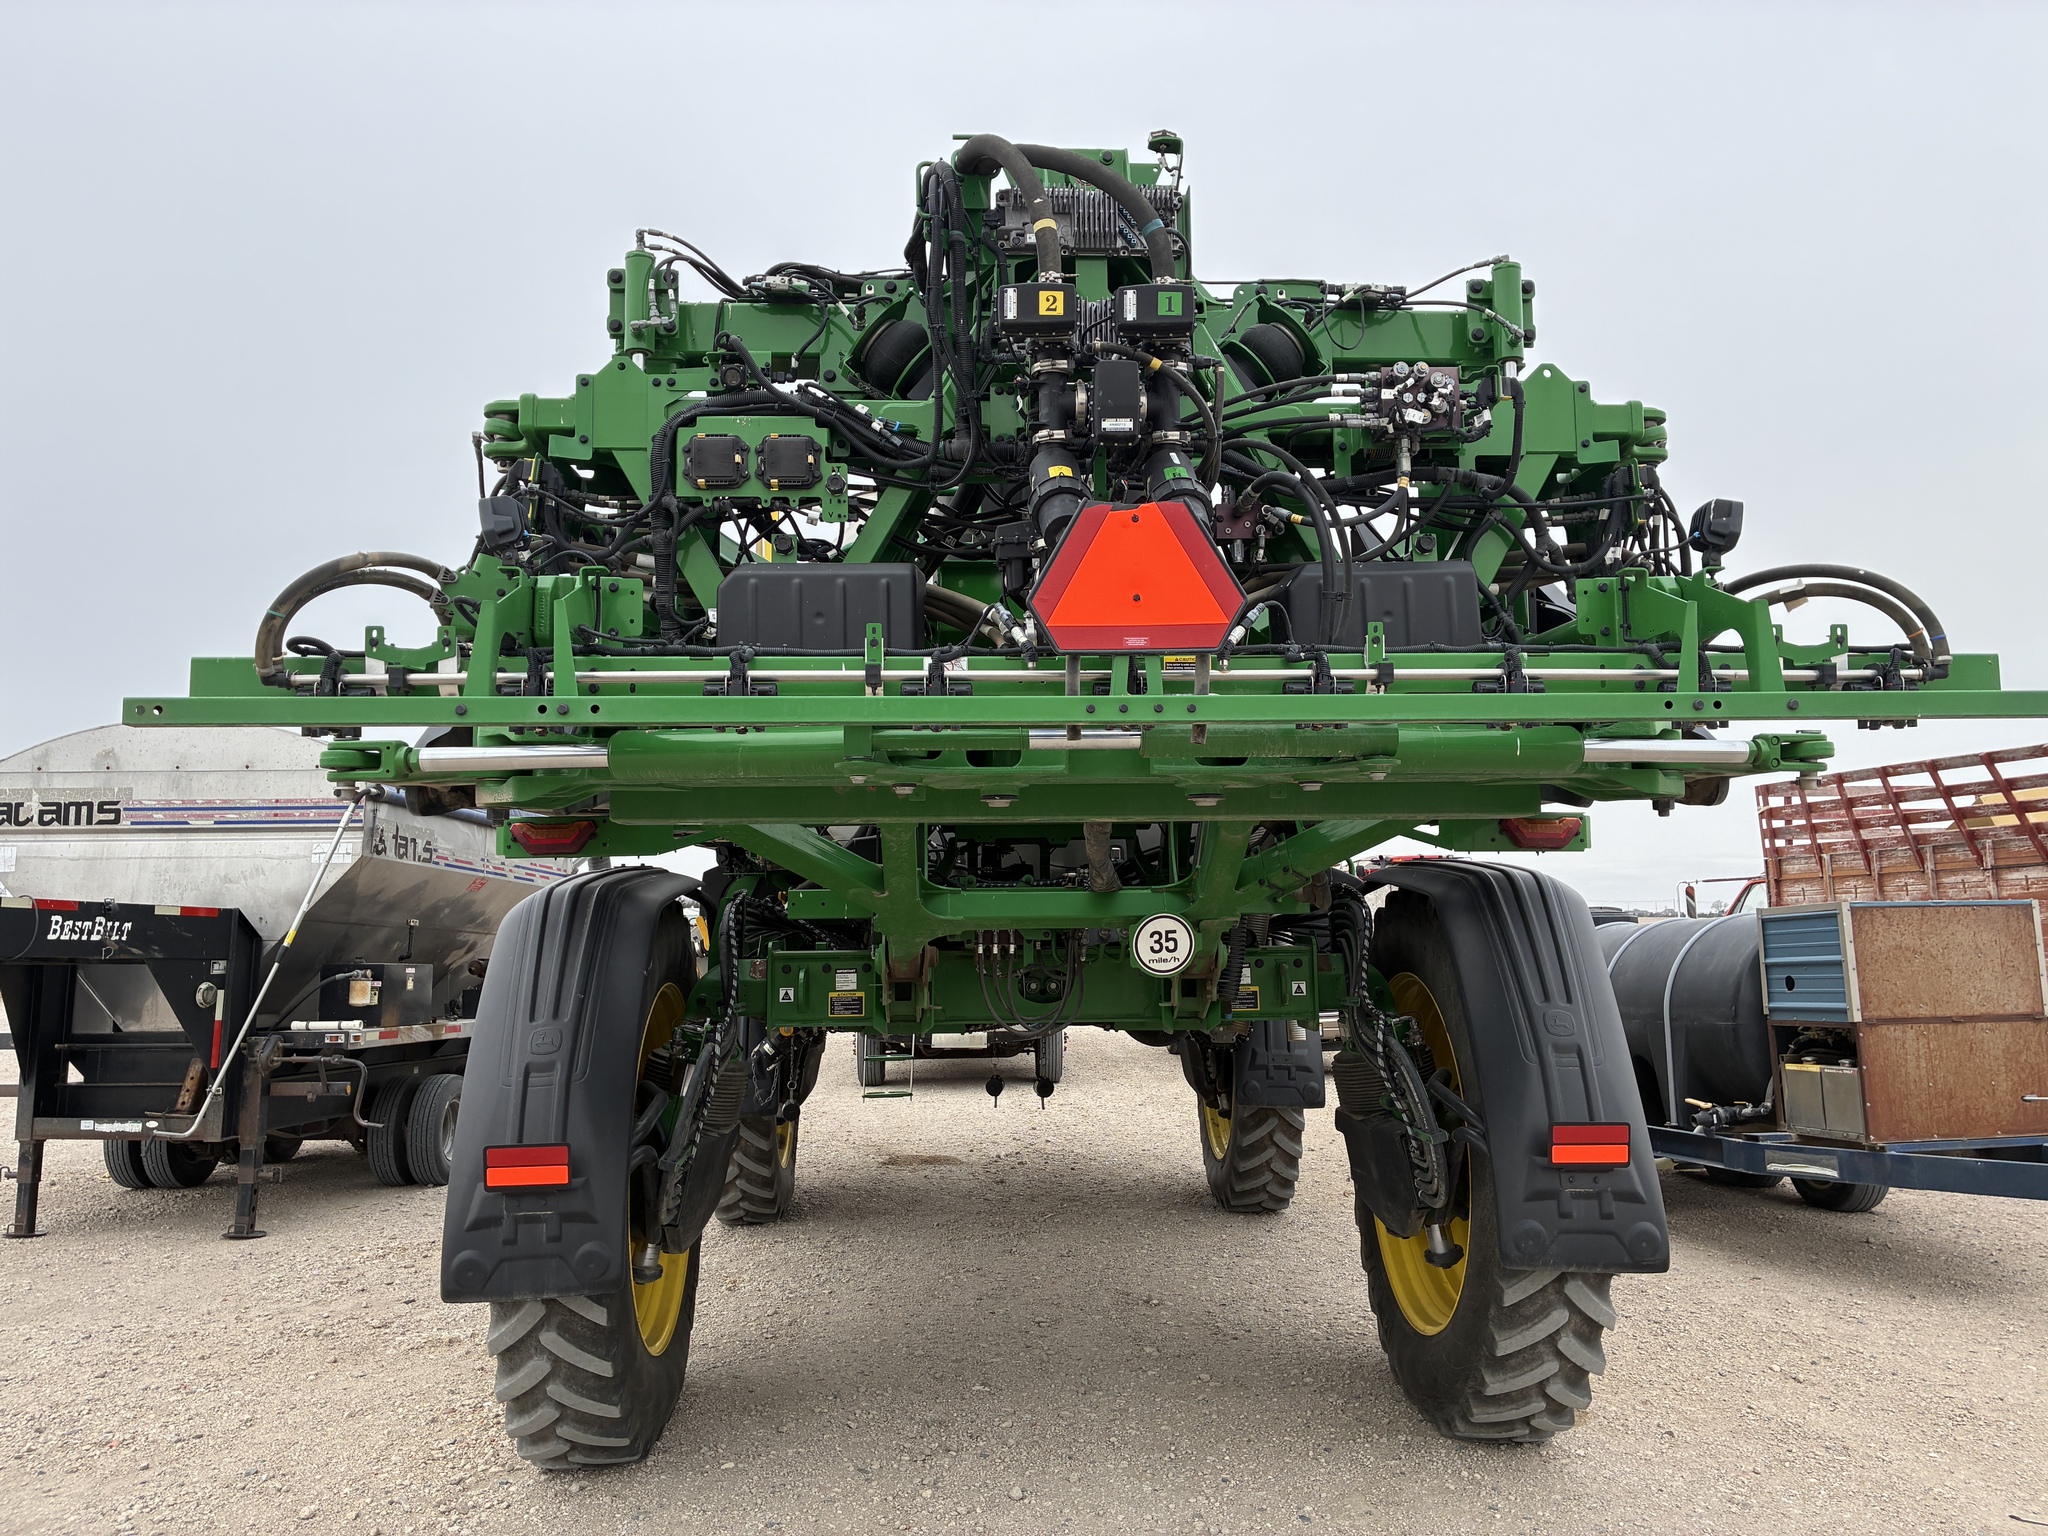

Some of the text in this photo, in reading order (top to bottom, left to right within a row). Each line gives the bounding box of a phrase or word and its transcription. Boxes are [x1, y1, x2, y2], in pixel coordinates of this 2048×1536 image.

[1045, 295, 1057, 312] 2
[1165, 296, 1175, 312] 1
[1149, 930, 1178, 954] 35
[1149, 956, 1180, 964] mile/h
